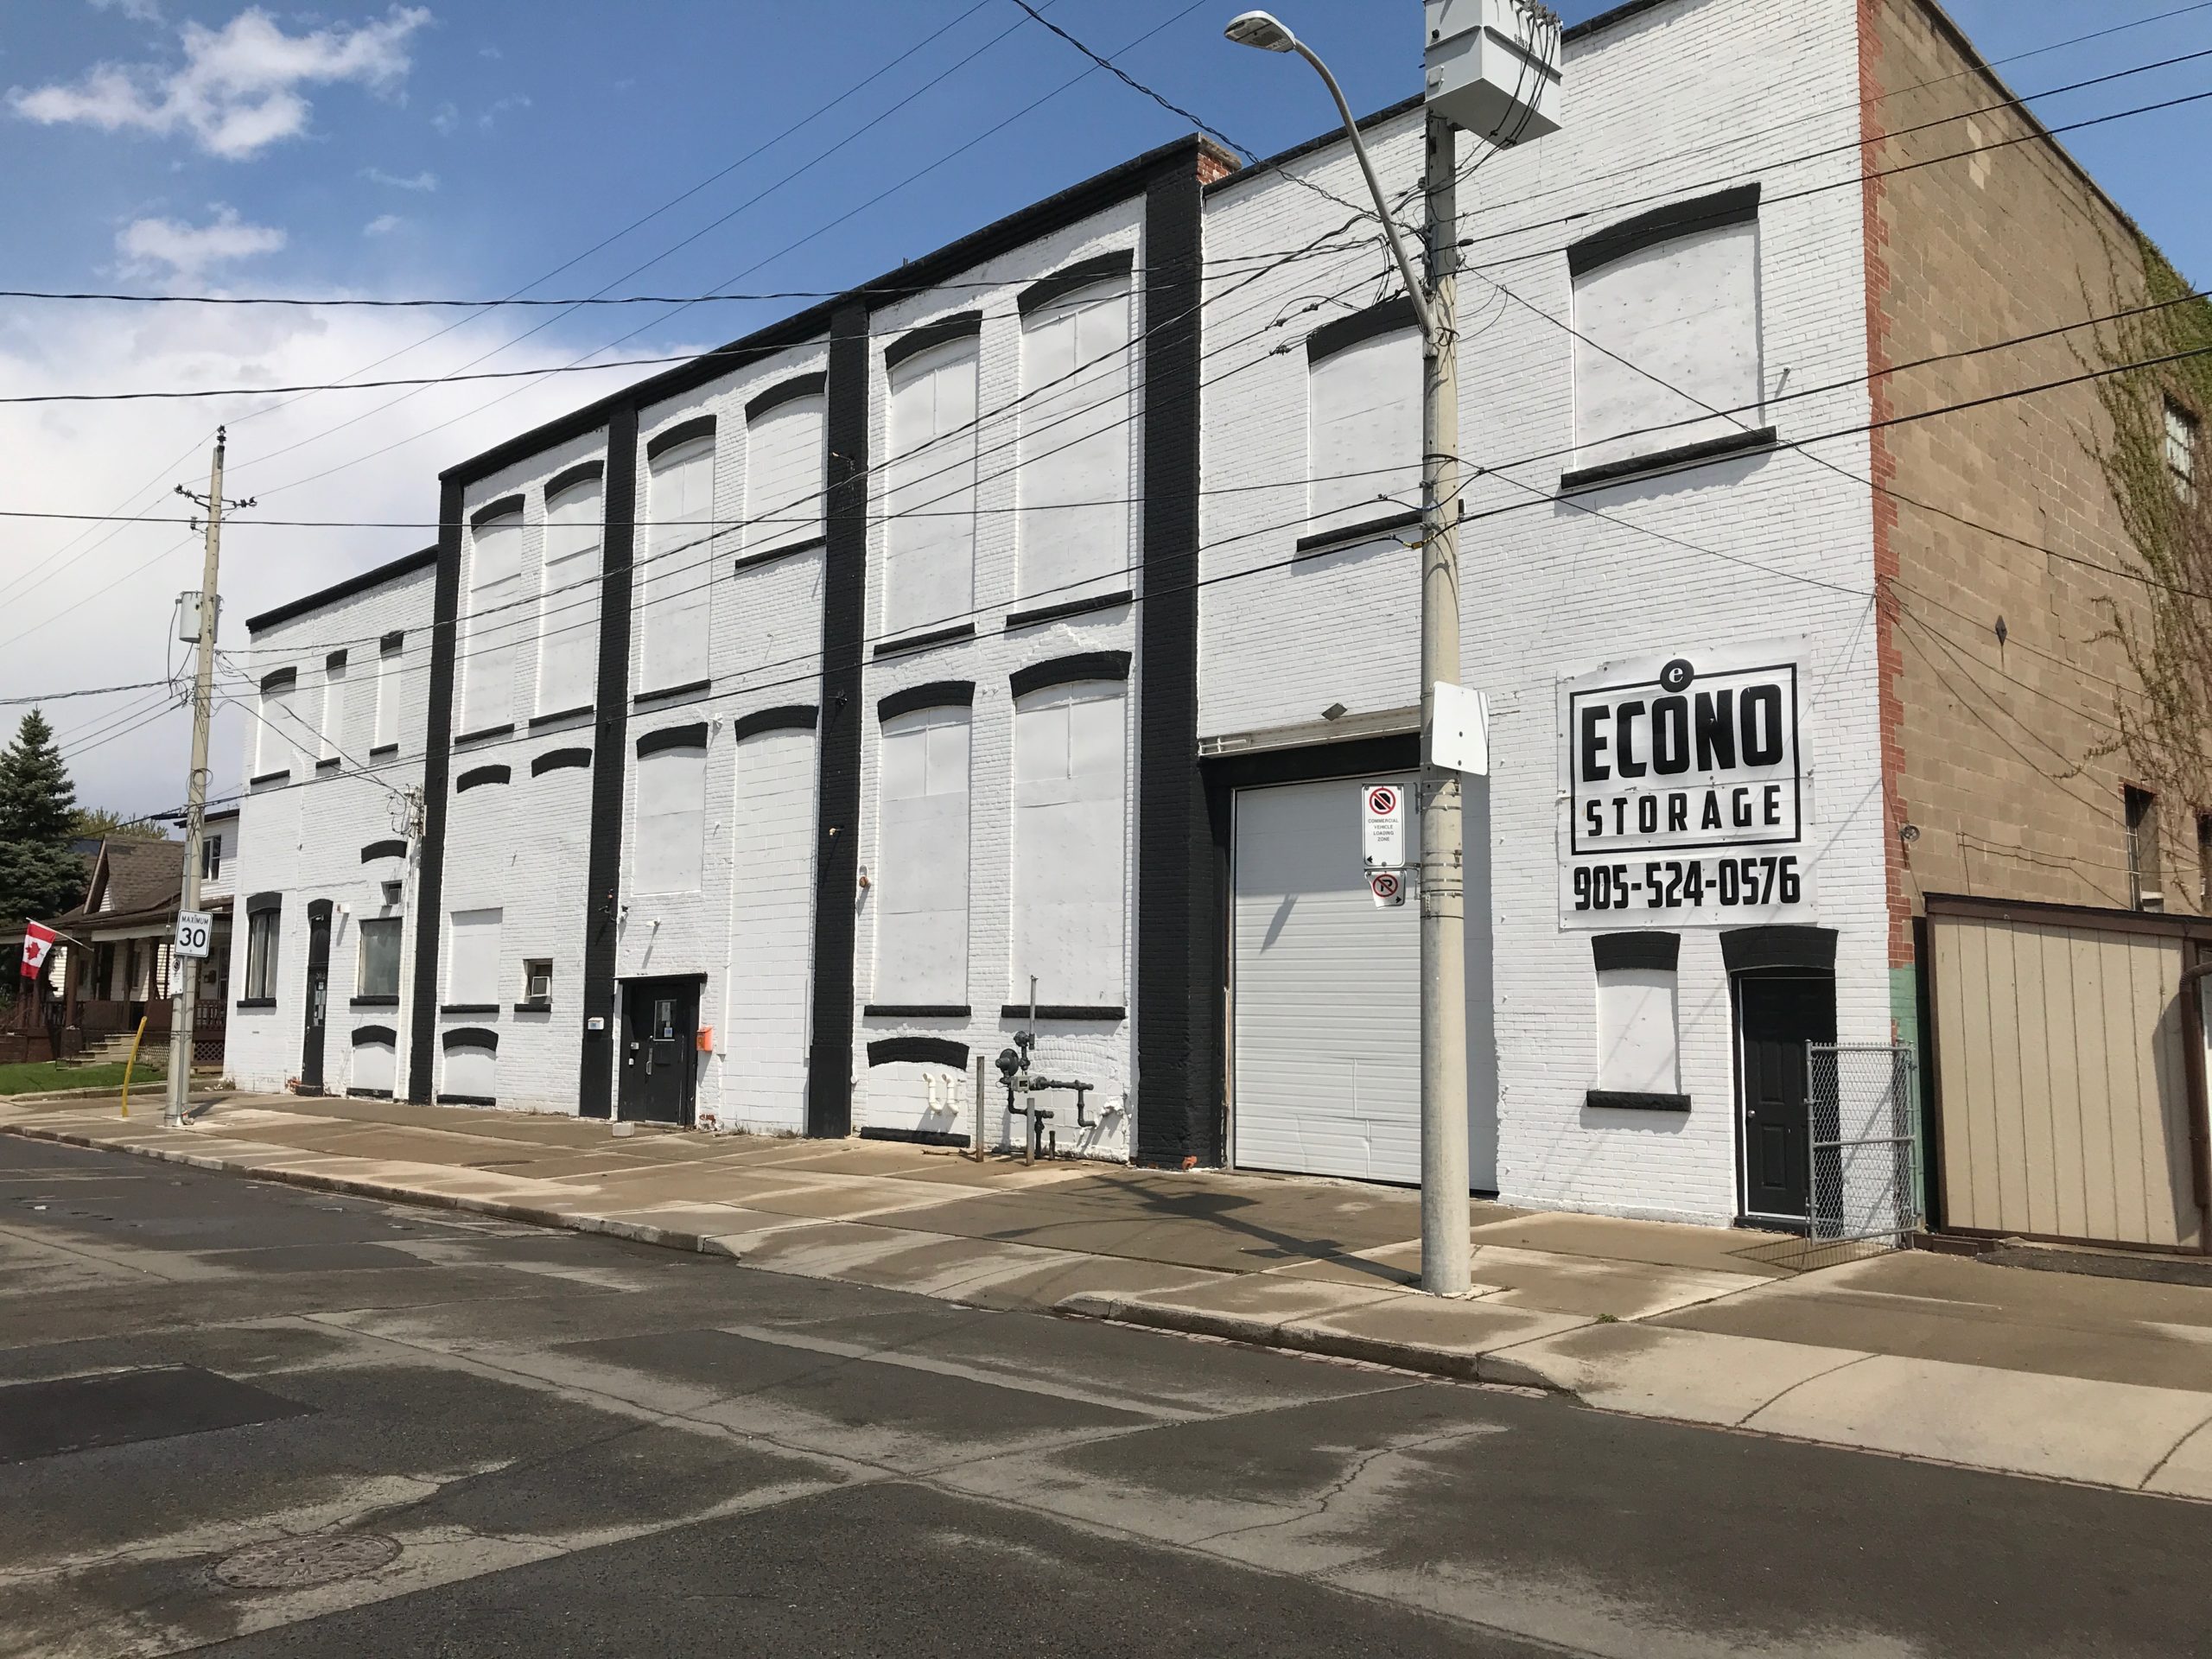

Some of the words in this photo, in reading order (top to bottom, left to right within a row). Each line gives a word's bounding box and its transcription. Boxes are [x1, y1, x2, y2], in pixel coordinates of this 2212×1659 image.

[1669, 667, 1683, 683] e
[1582, 683, 1783, 783] ECONO
[1586, 785, 1781, 836] STORAGE
[1573, 855, 1801, 911] 905-524-0576
[180, 927, 206, 948] 30
[181, 915, 209, 925] MAXIMUM
